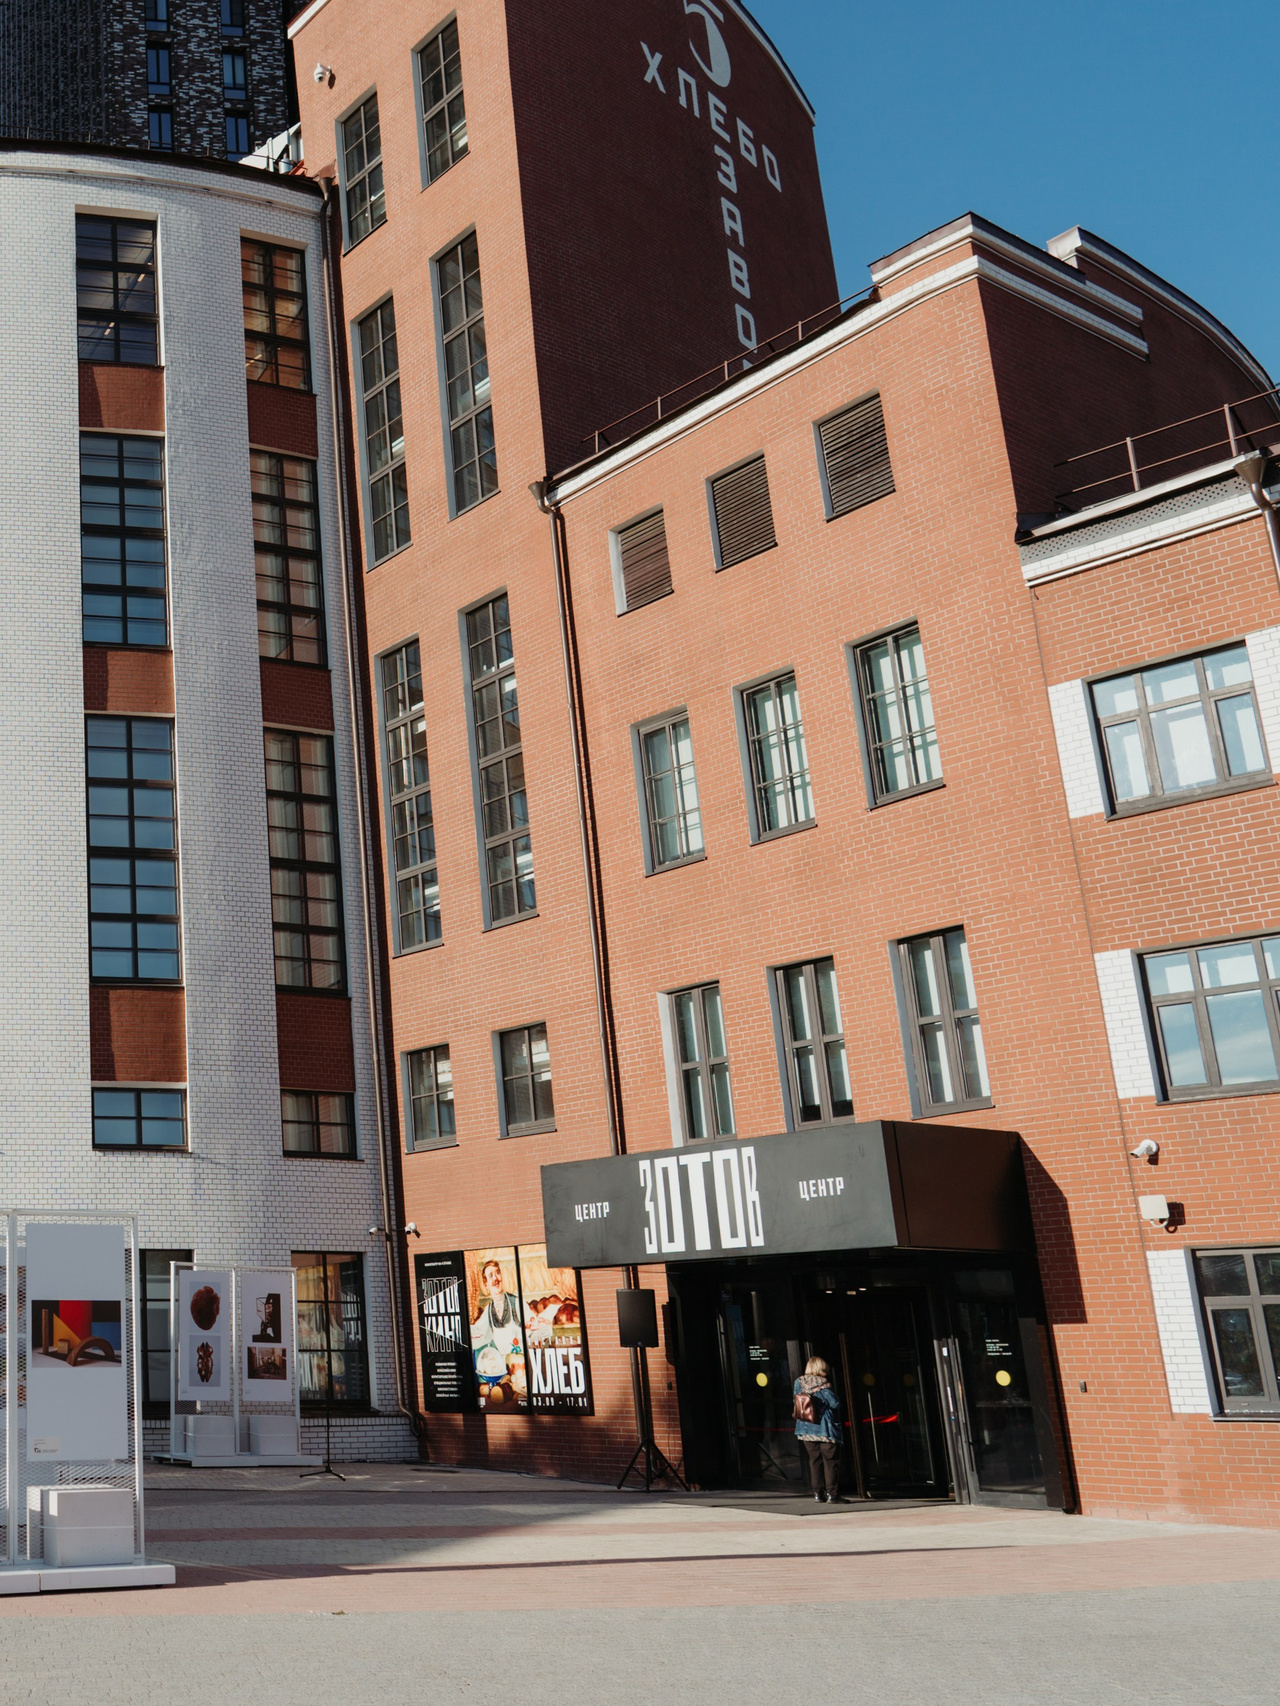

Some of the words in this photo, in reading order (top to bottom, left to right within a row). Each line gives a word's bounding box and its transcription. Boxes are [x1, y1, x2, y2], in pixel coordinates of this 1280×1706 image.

[714, 145, 758, 371] ЗАВО
[575, 1201, 610, 1223] ЦЕНТР
[638, 1146, 765, 1254] ЗОТОВ
[799, 1177, 844, 1201] ЦЕНТР
[528, 1347, 586, 1395] ХЛЕБ
